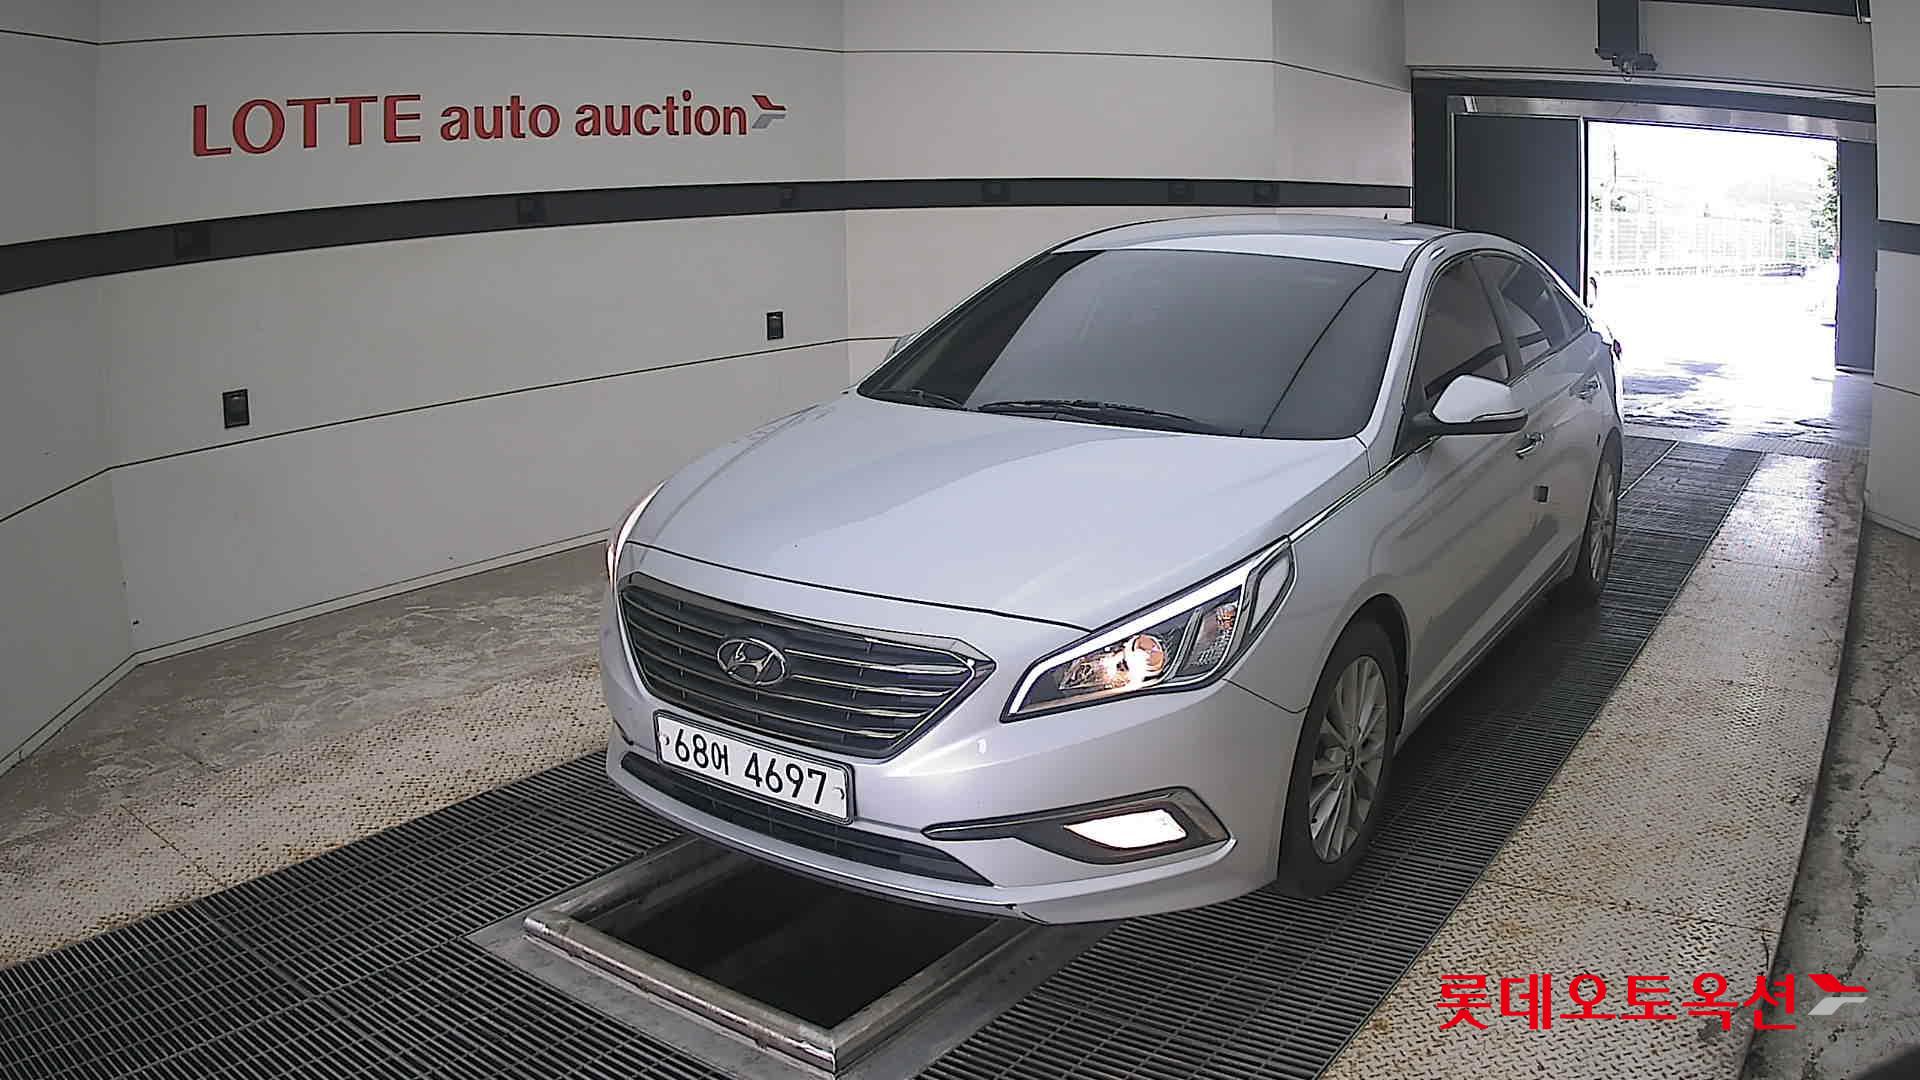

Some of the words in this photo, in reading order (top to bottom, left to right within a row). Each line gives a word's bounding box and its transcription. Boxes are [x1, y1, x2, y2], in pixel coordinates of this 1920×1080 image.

[193, 95, 422, 156] LOTTE
[440, 95, 561, 140] auto
[575, 89, 748, 136] auction
[674, 728, 730, 776] 68어
[744, 751, 828, 805] 4697
